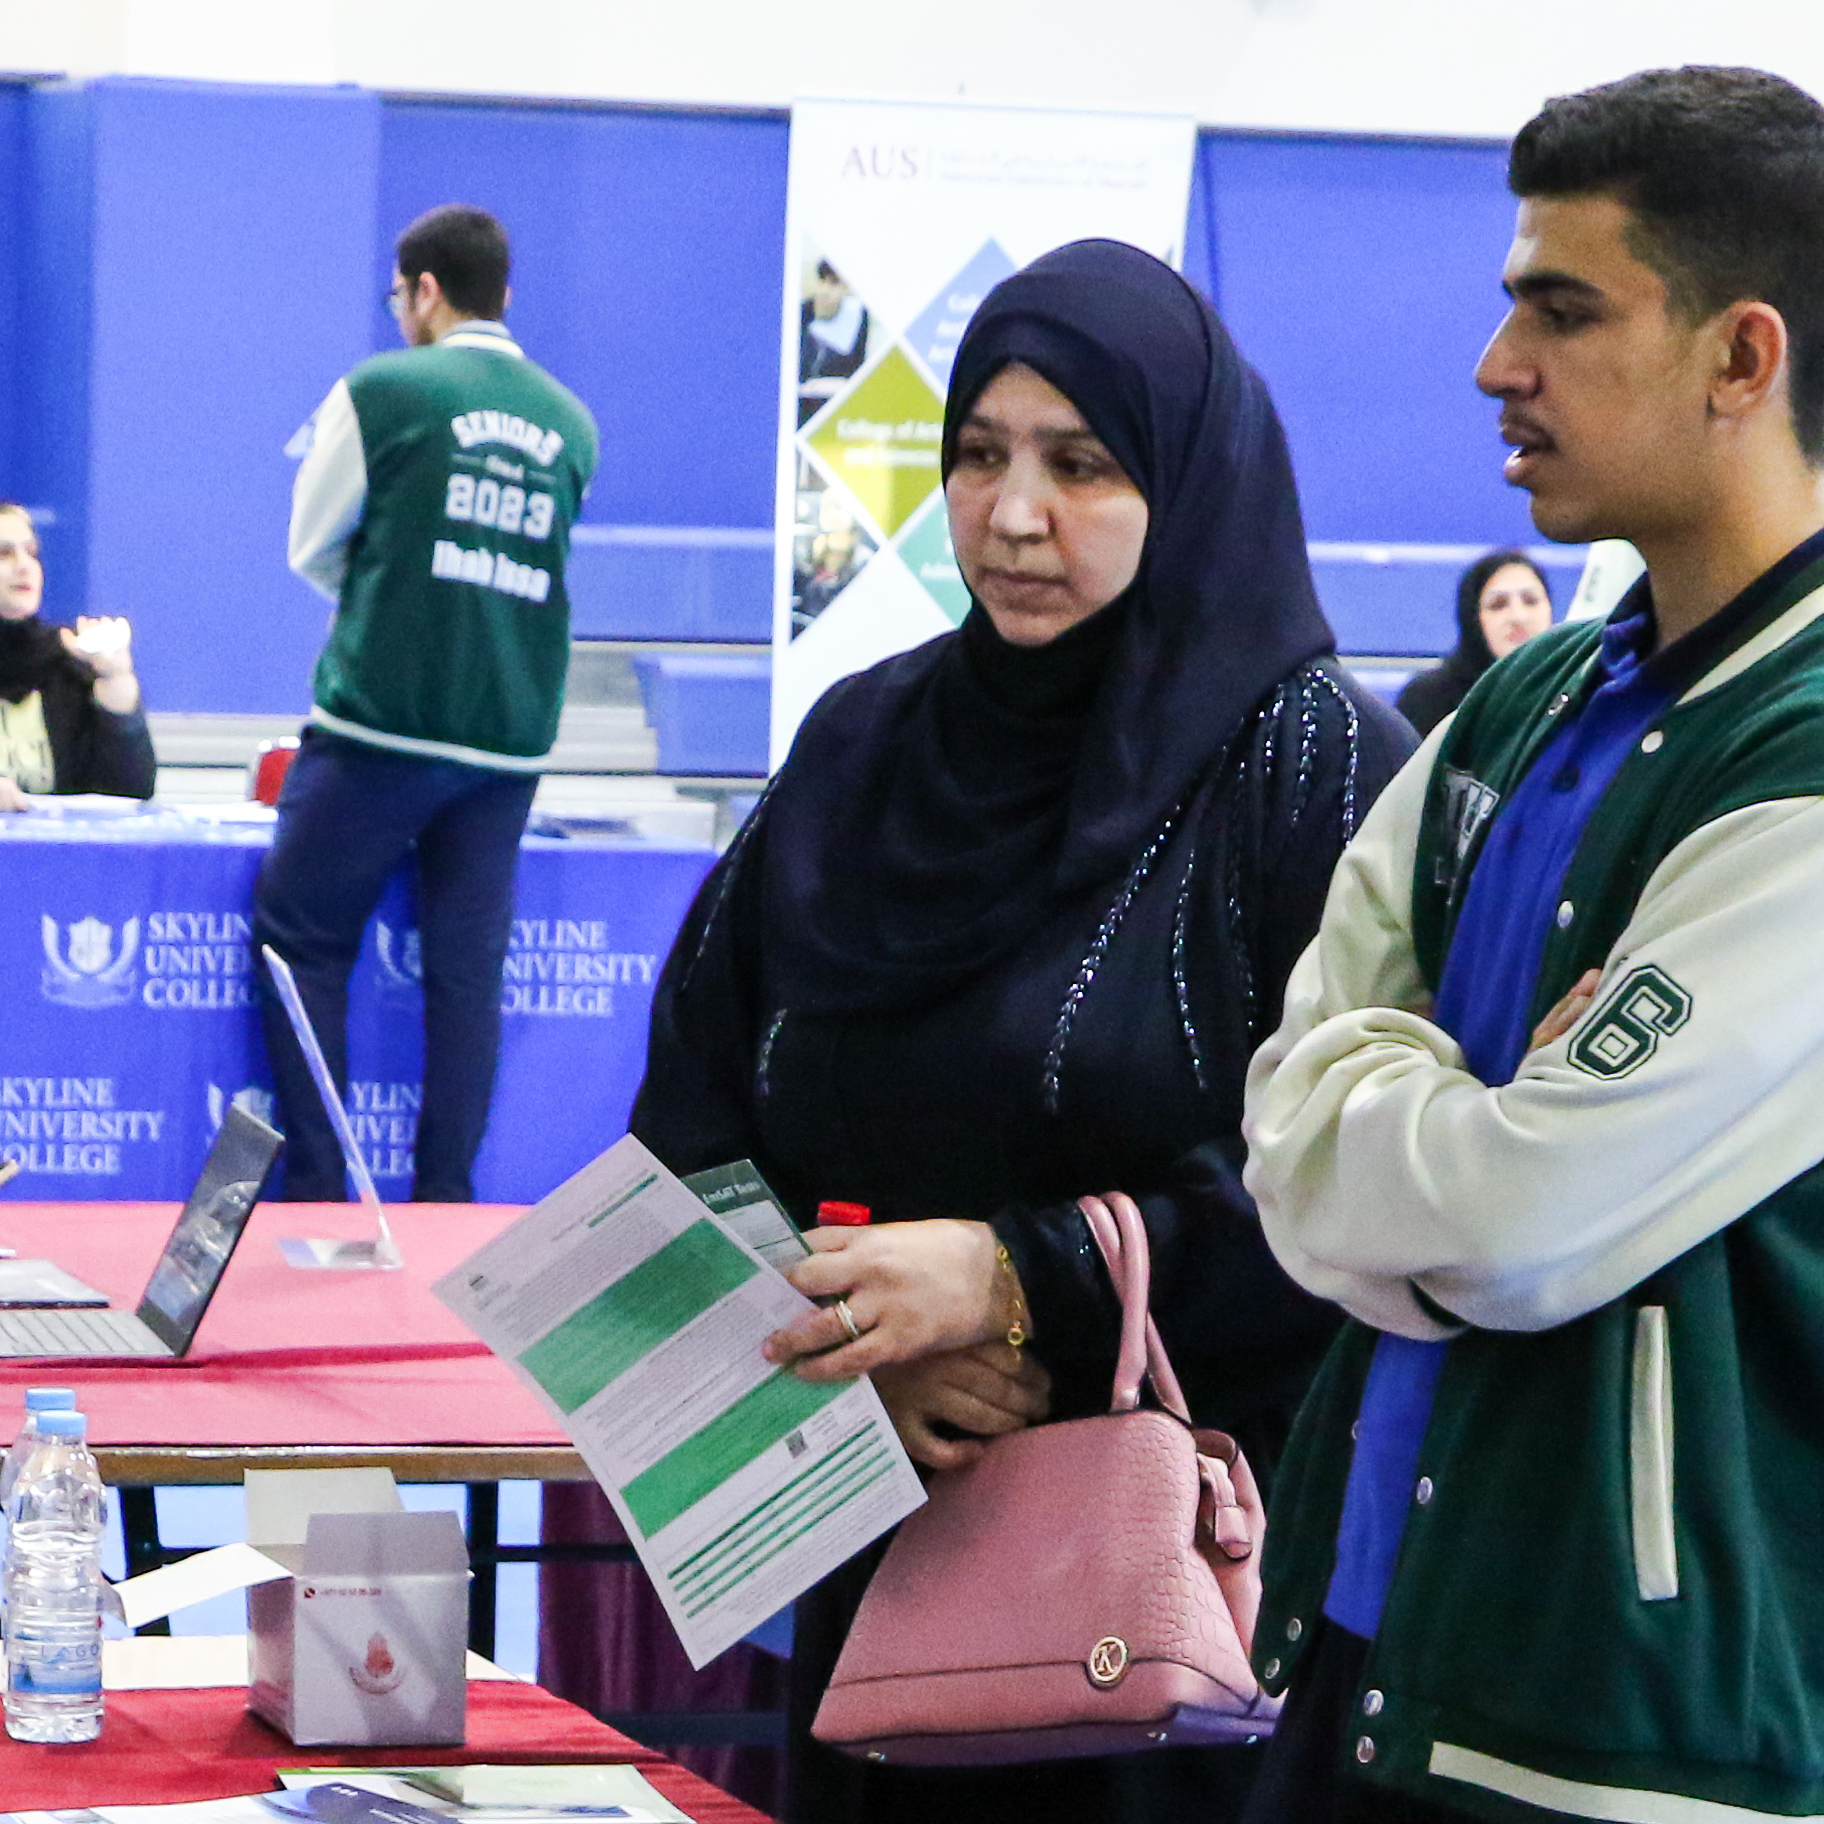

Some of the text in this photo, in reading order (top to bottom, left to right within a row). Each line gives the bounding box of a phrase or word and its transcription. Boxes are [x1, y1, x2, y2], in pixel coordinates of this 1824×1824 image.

[841, 145, 919, 180] AUS
[451, 409, 565, 468] SENIORS
[445, 472, 555, 541] 2023
[148, 911, 253, 943] SKYLIN
[509, 919, 608, 950] KYLINE
[146, 945, 253, 977] UNIVE
[502, 951, 657, 983] NIVERSITY
[143, 976, 253, 1008] COLLE
[501, 983, 614, 1017] OLLEGE
[1567, 963, 1693, 1081] 6
